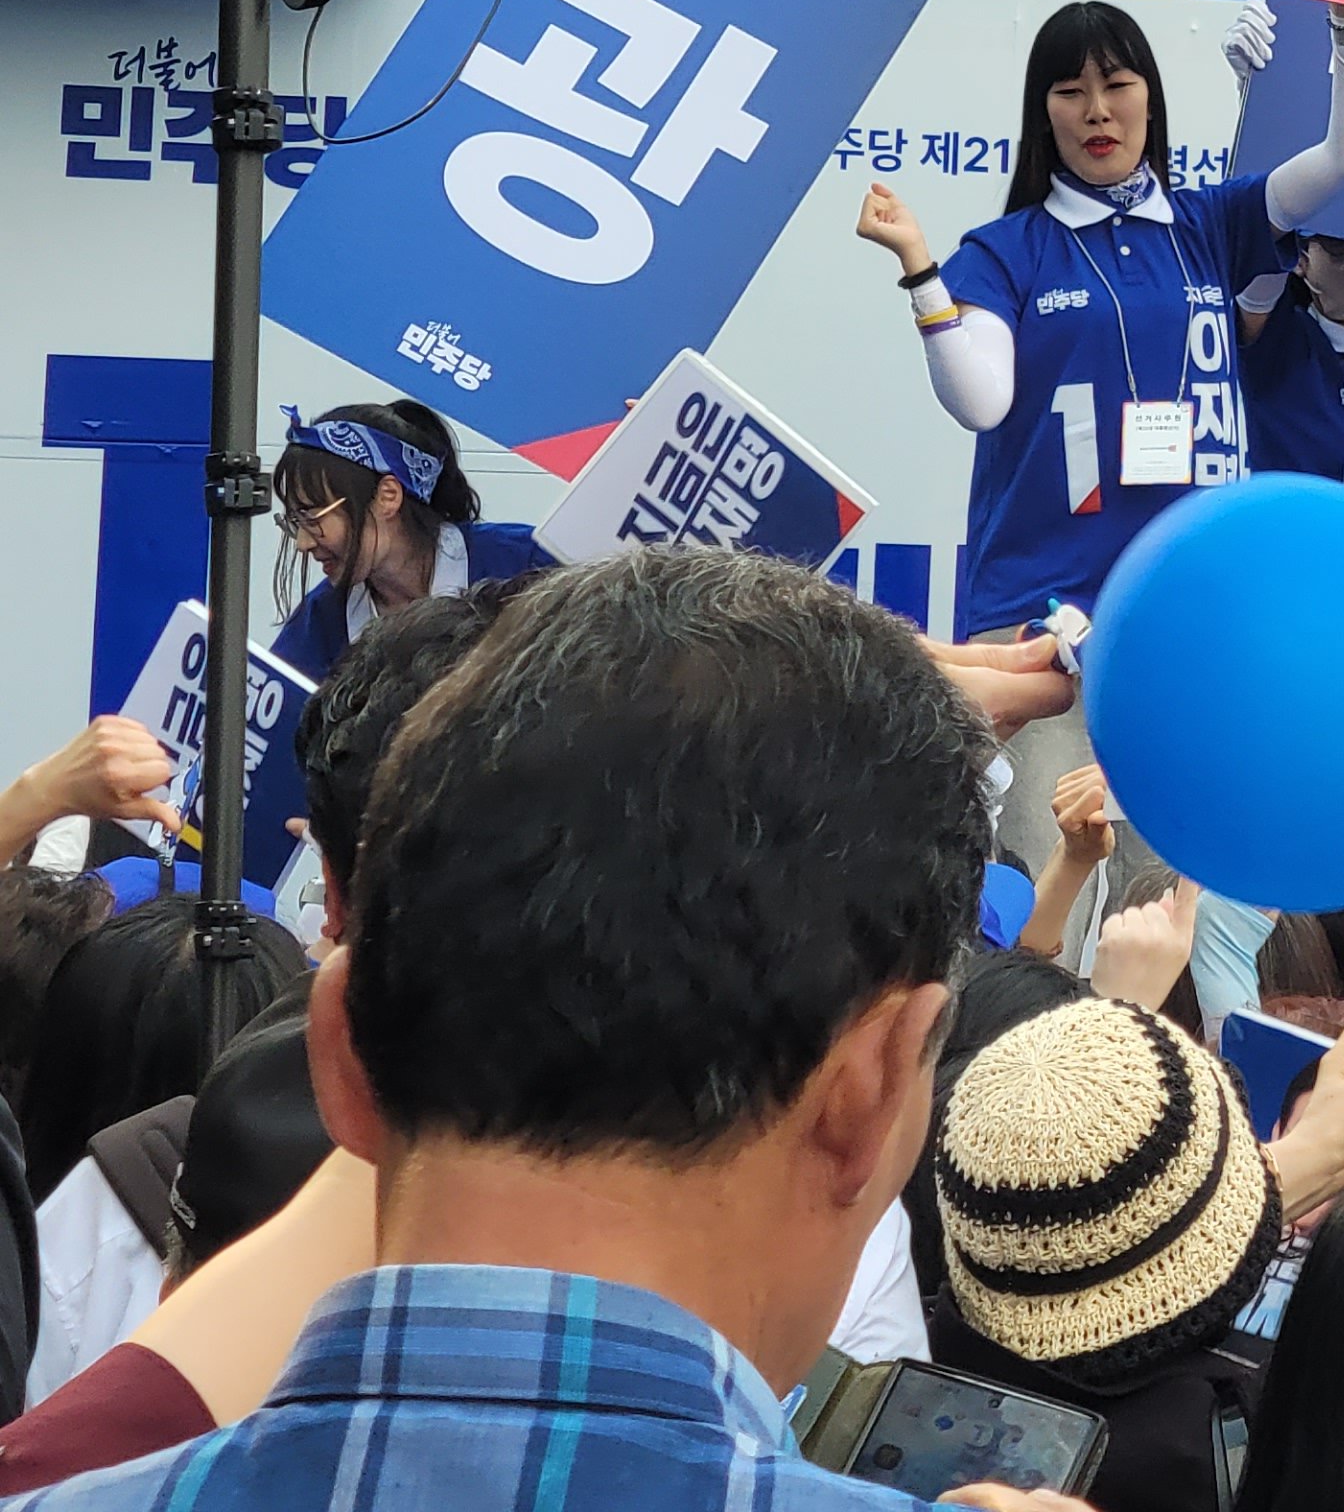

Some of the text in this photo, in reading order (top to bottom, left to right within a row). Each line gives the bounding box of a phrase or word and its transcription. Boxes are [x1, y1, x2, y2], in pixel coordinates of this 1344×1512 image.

[108, 36, 218, 90] 더불어
[1036, 289, 1090, 316] 민주당
[396, 322, 492, 392] 민주당
[616, 391, 736, 545] 지금은
[690, 425, 786, 554] 재명
[1051, 383, 1103, 515] 1
